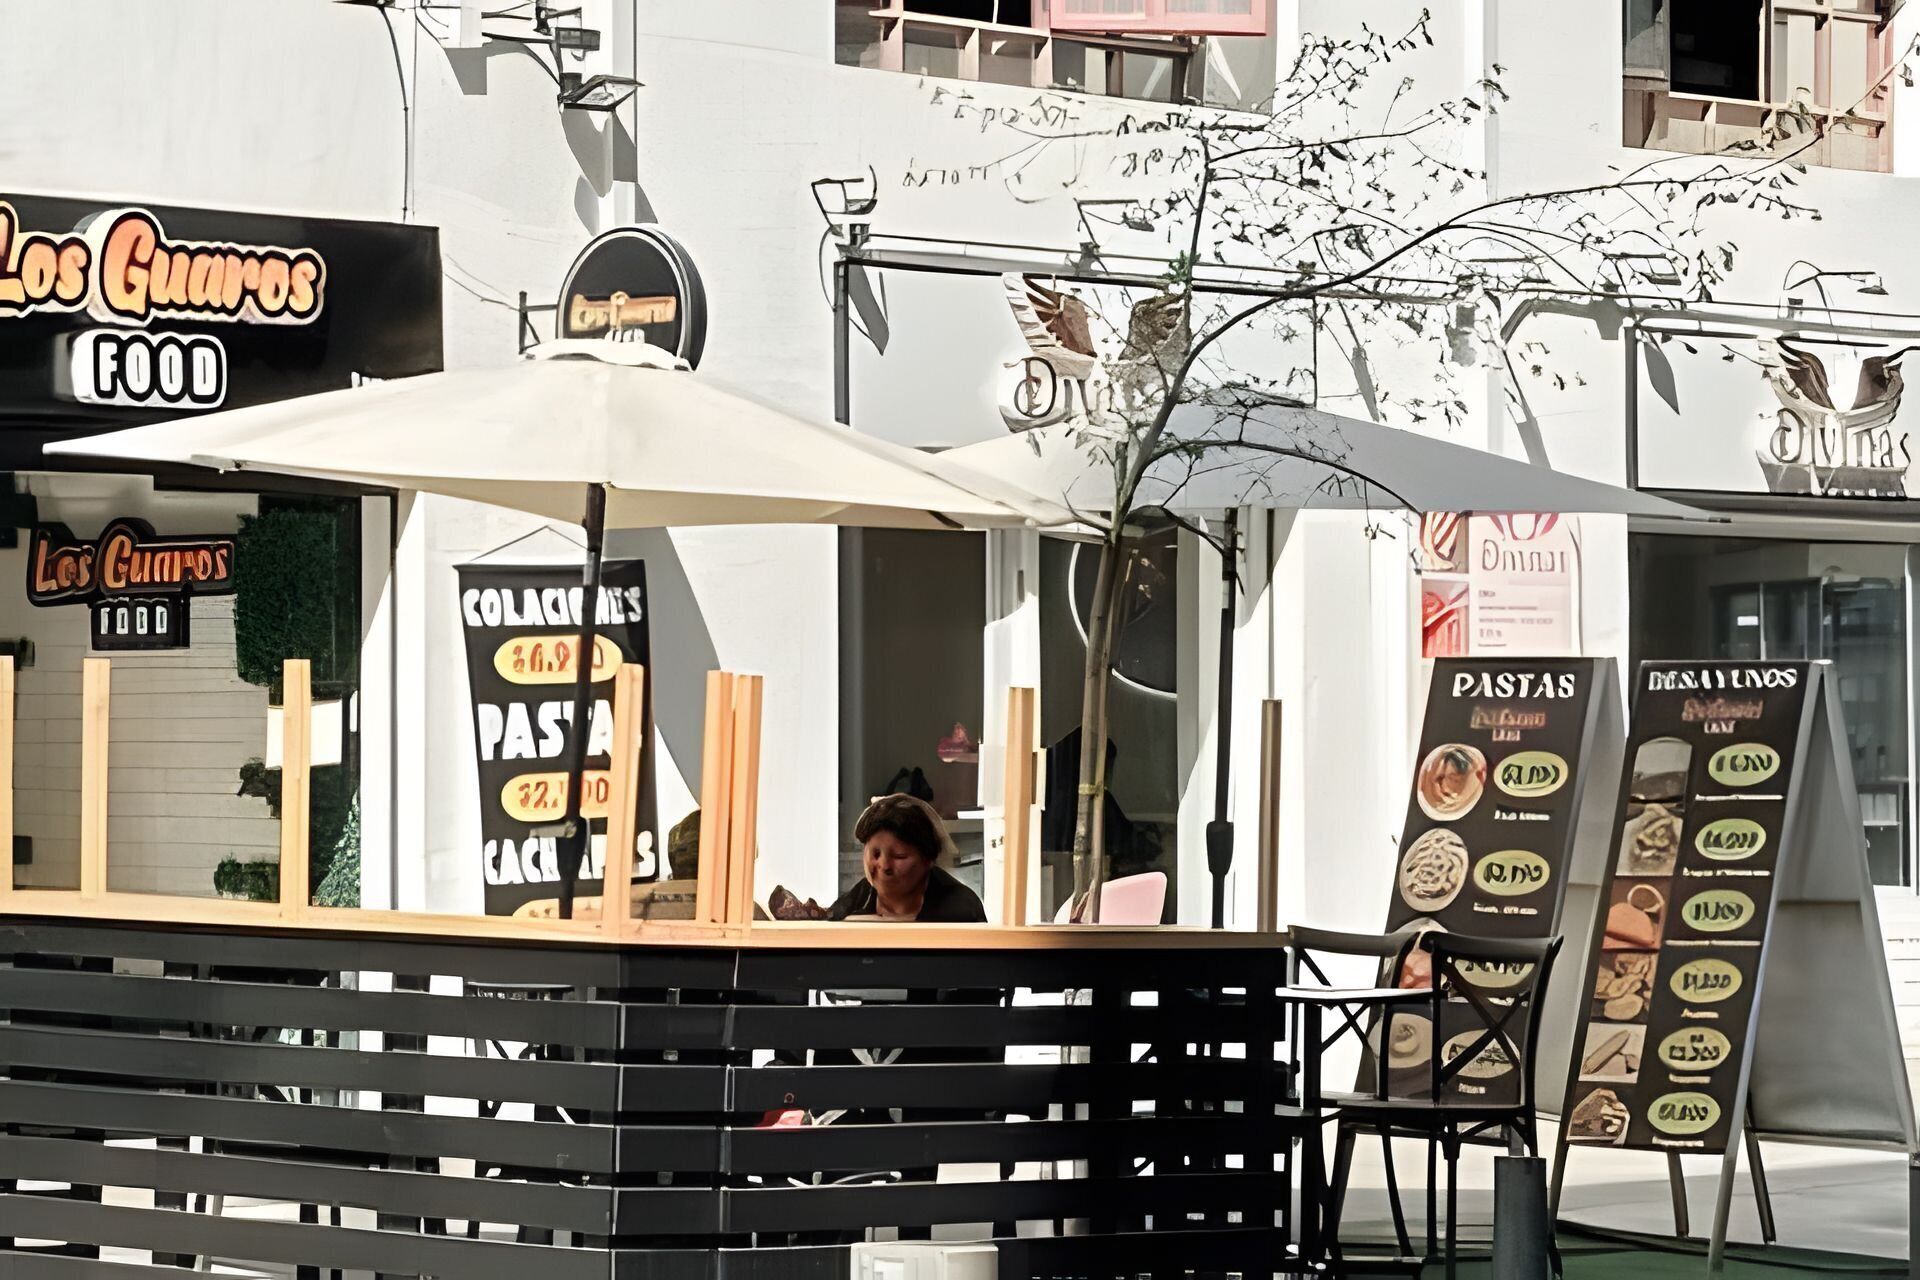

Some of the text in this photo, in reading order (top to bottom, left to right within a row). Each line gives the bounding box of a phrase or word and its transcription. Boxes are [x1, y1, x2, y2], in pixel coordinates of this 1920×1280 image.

[0, 207, 322, 319] Los Guaros
[95, 335, 221, 402] FOOD
[36, 539, 92, 592] Los
[1452, 672, 1575, 698] PASTAS
